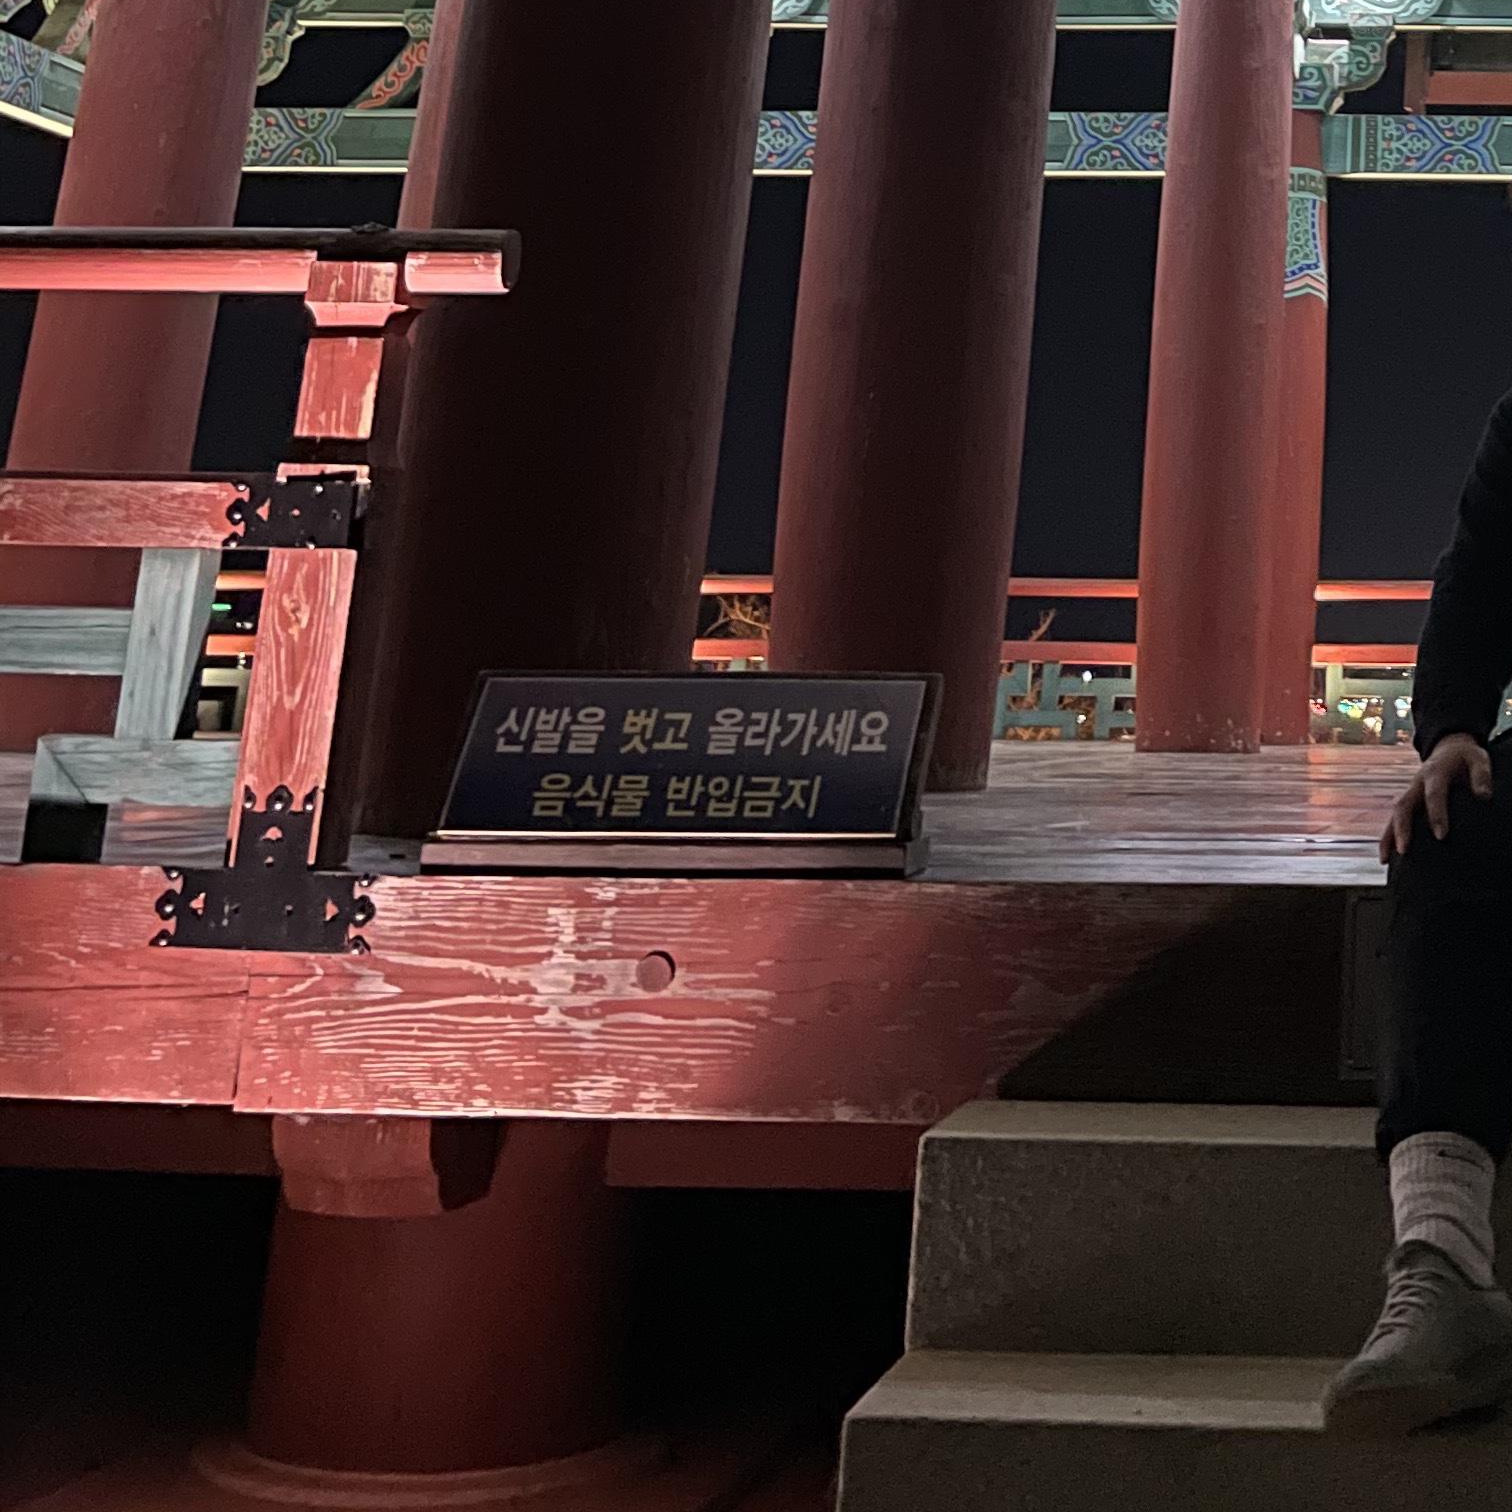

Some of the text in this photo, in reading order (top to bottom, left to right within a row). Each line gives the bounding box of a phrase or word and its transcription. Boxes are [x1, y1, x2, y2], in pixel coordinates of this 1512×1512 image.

[496, 706, 890, 756] 신발을 벗고 올라가세요
[532, 773, 822, 819] 음식물 반입금지
